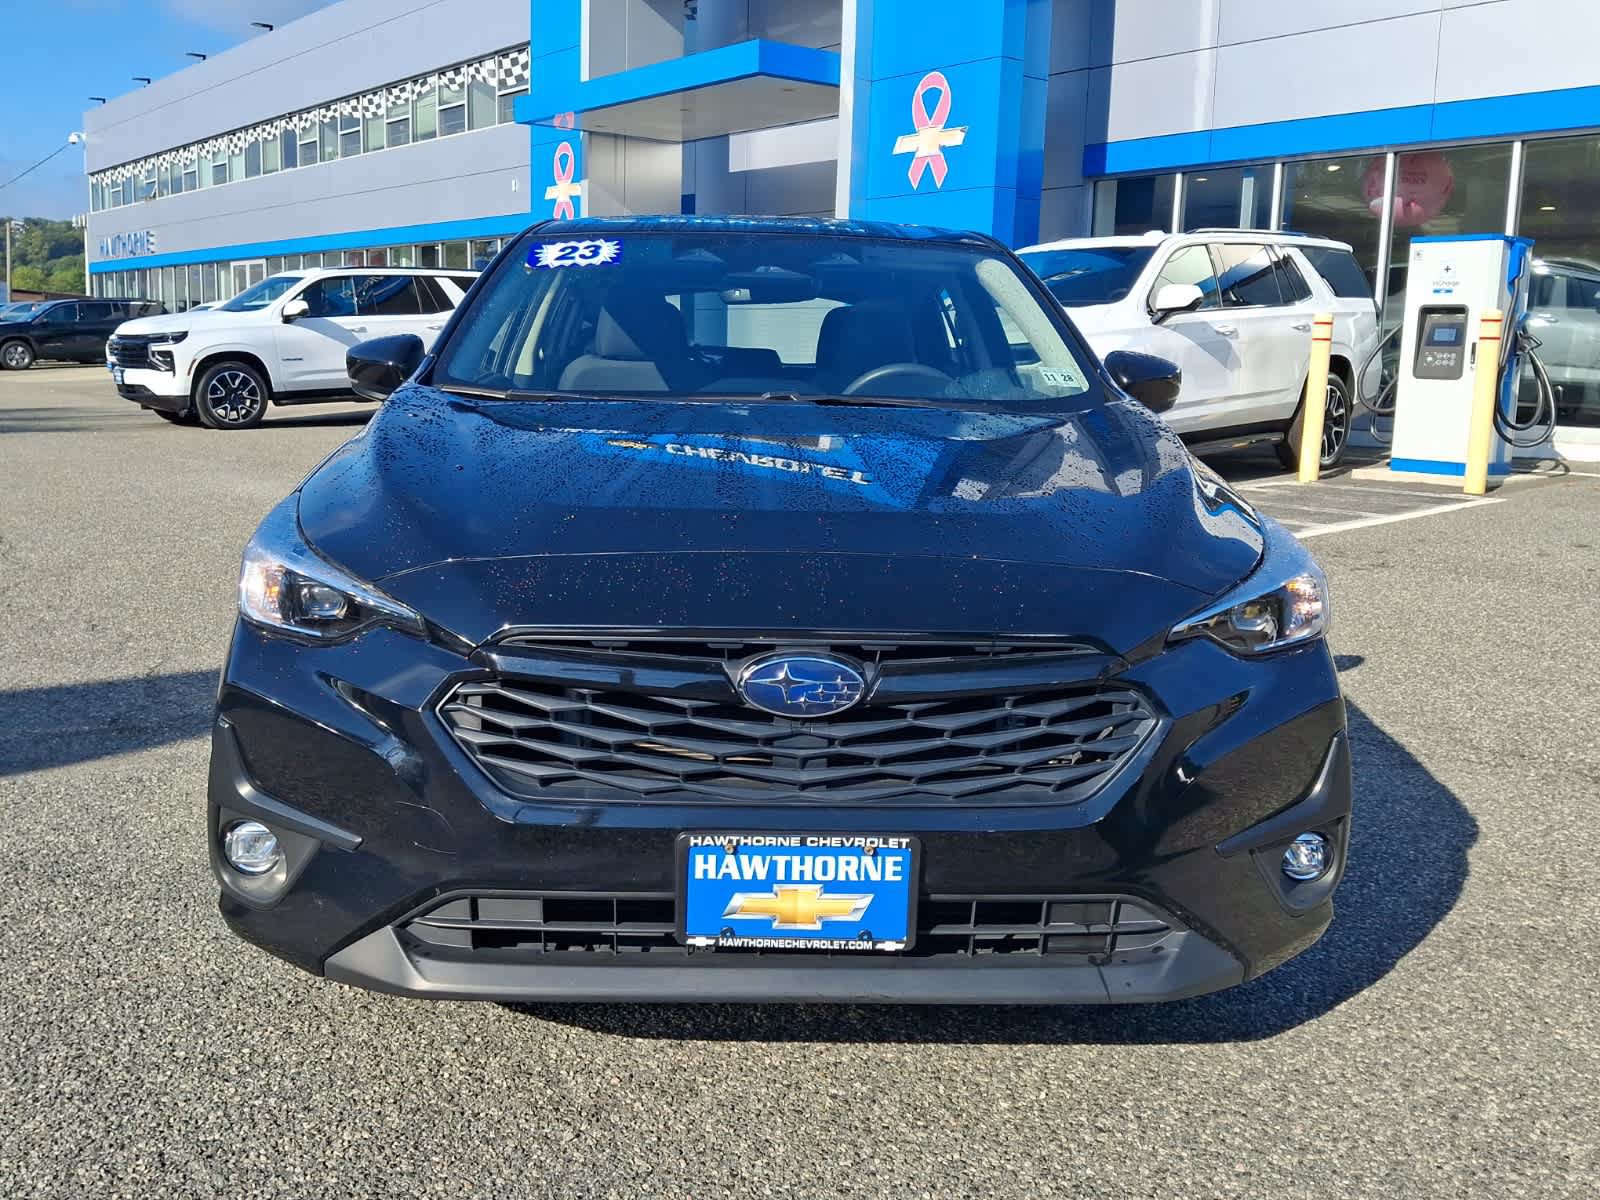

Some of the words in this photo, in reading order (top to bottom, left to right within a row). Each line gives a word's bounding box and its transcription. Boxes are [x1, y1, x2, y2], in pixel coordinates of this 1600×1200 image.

[554, 244, 603, 261] 23
[1044, 373, 1057, 382] 11
[689, 835, 801, 848] HAWTHORNE
[806, 836, 910, 849] CHEVROLET
[694, 854, 903, 881] HAWTHORNE
[719, 937, 873, 950] HAWTHORNECHEVROLET.COM
